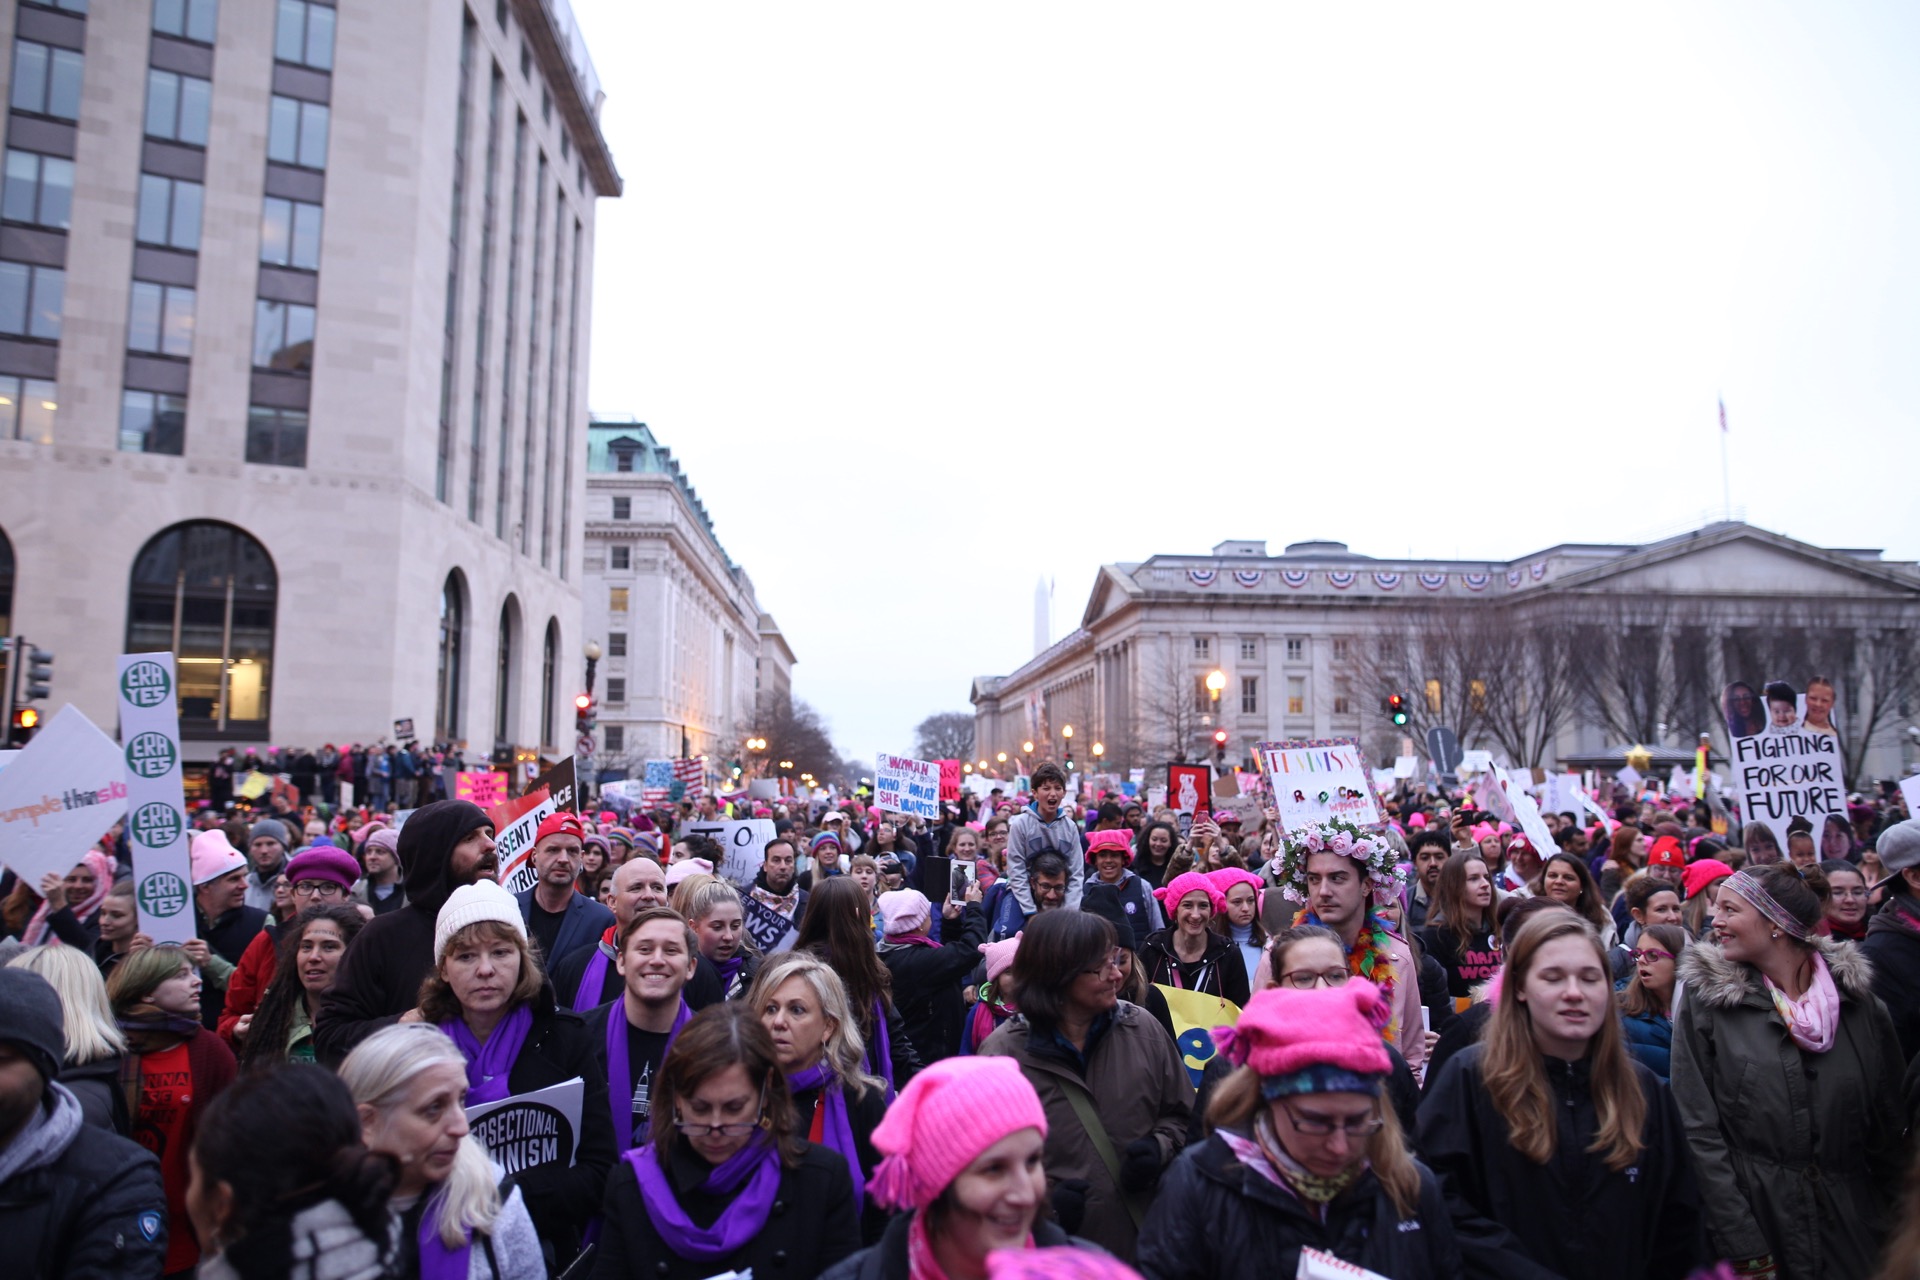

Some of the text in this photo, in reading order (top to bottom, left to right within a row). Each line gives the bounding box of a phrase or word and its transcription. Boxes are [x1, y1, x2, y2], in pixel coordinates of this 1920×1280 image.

[127, 662, 164, 687] ERA
[125, 685, 166, 705] YES
[132, 733, 169, 758] ERA
[1737, 734, 1835, 762] FIGHTING
[130, 756, 171, 776] YES
[1743, 762, 1834, 790] FOR OUR
[880, 791, 899, 807] SHE
[909, 783, 936, 801] WHAT
[1746, 786, 1843, 820] FUTURE
[138, 803, 174, 829] ERA
[136, 827, 177, 847] YES
[143, 873, 180, 899] ERA
[142, 896, 183, 916] YES
[757, 905, 786, 929] YOUR
